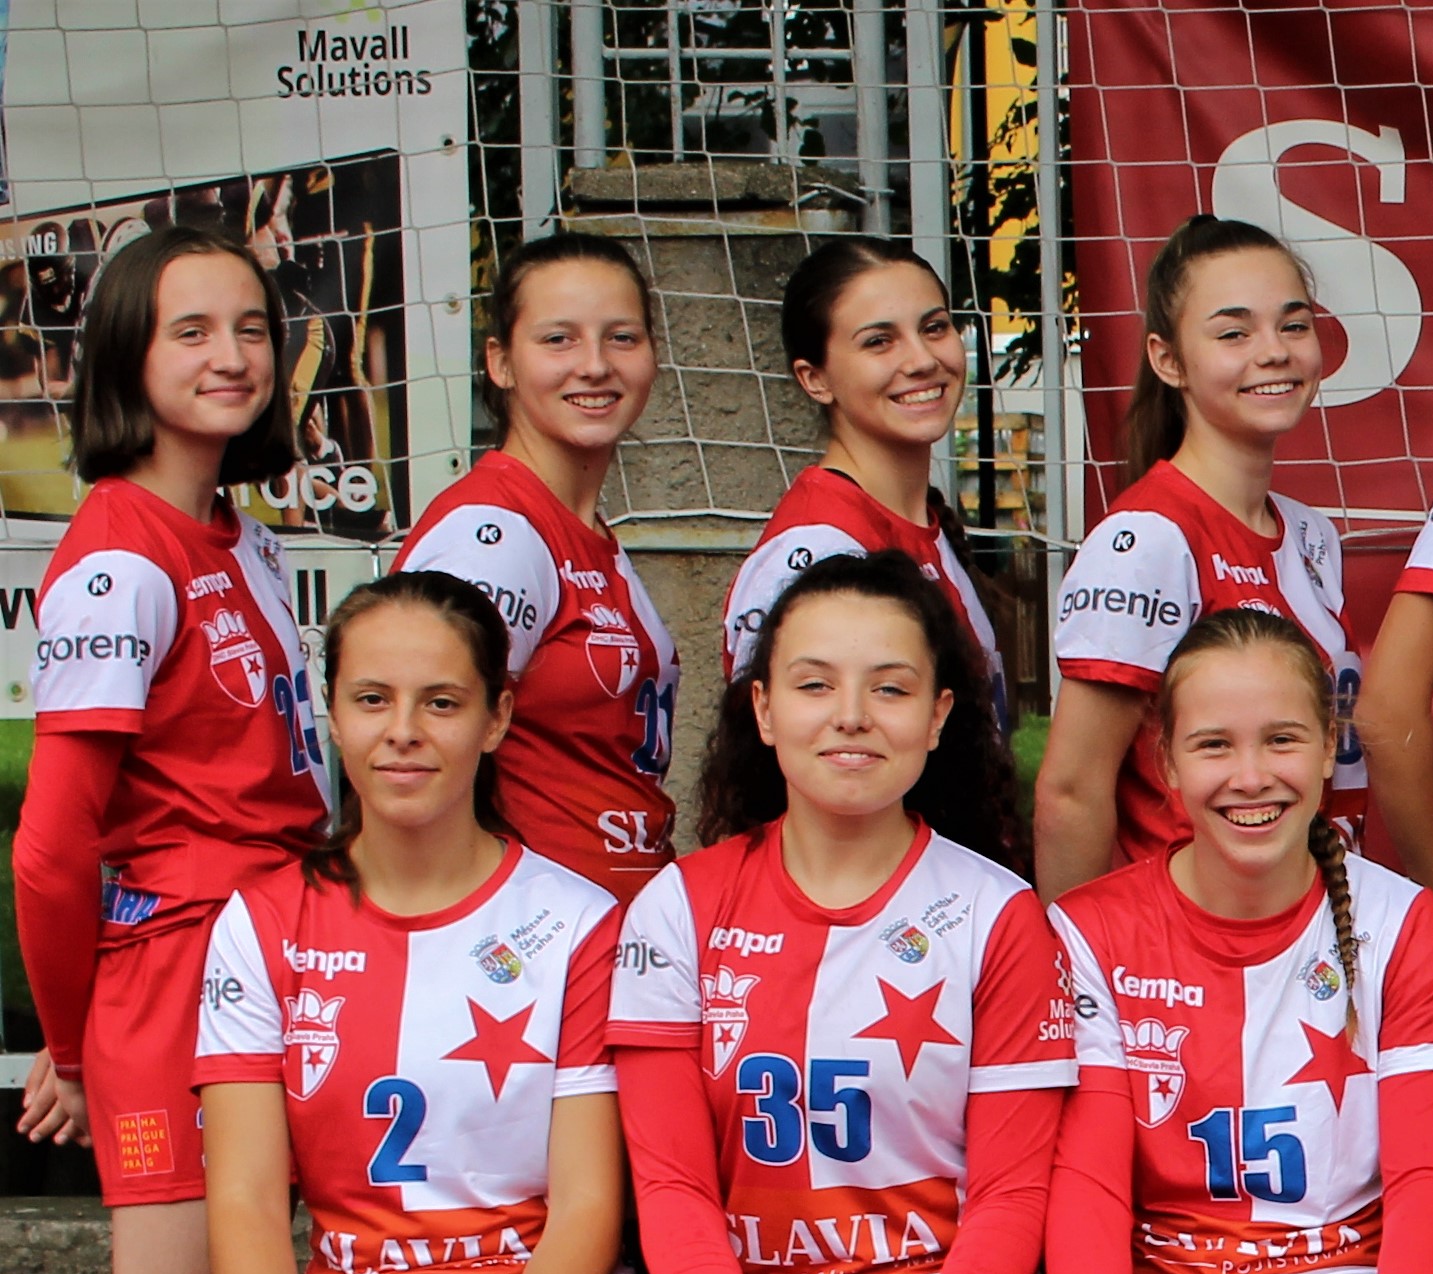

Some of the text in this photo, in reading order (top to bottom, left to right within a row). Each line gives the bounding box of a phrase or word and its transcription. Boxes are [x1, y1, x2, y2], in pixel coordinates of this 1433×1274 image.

[298, 28, 409, 61] Mavall
[277, 66, 432, 98] Solutions
[478, 525, 501, 544] K
[1114, 532, 1135, 552] K
[90, 575, 111, 595] K
[1060, 587, 1182, 628] gorenje
[525, 920, 565, 959] Praha 10
[1112, 965, 1204, 1008] Kempa
[736, 1052, 873, 1167] 35
[364, 1075, 429, 1187] 2
[1187, 1105, 1308, 1204] 15
